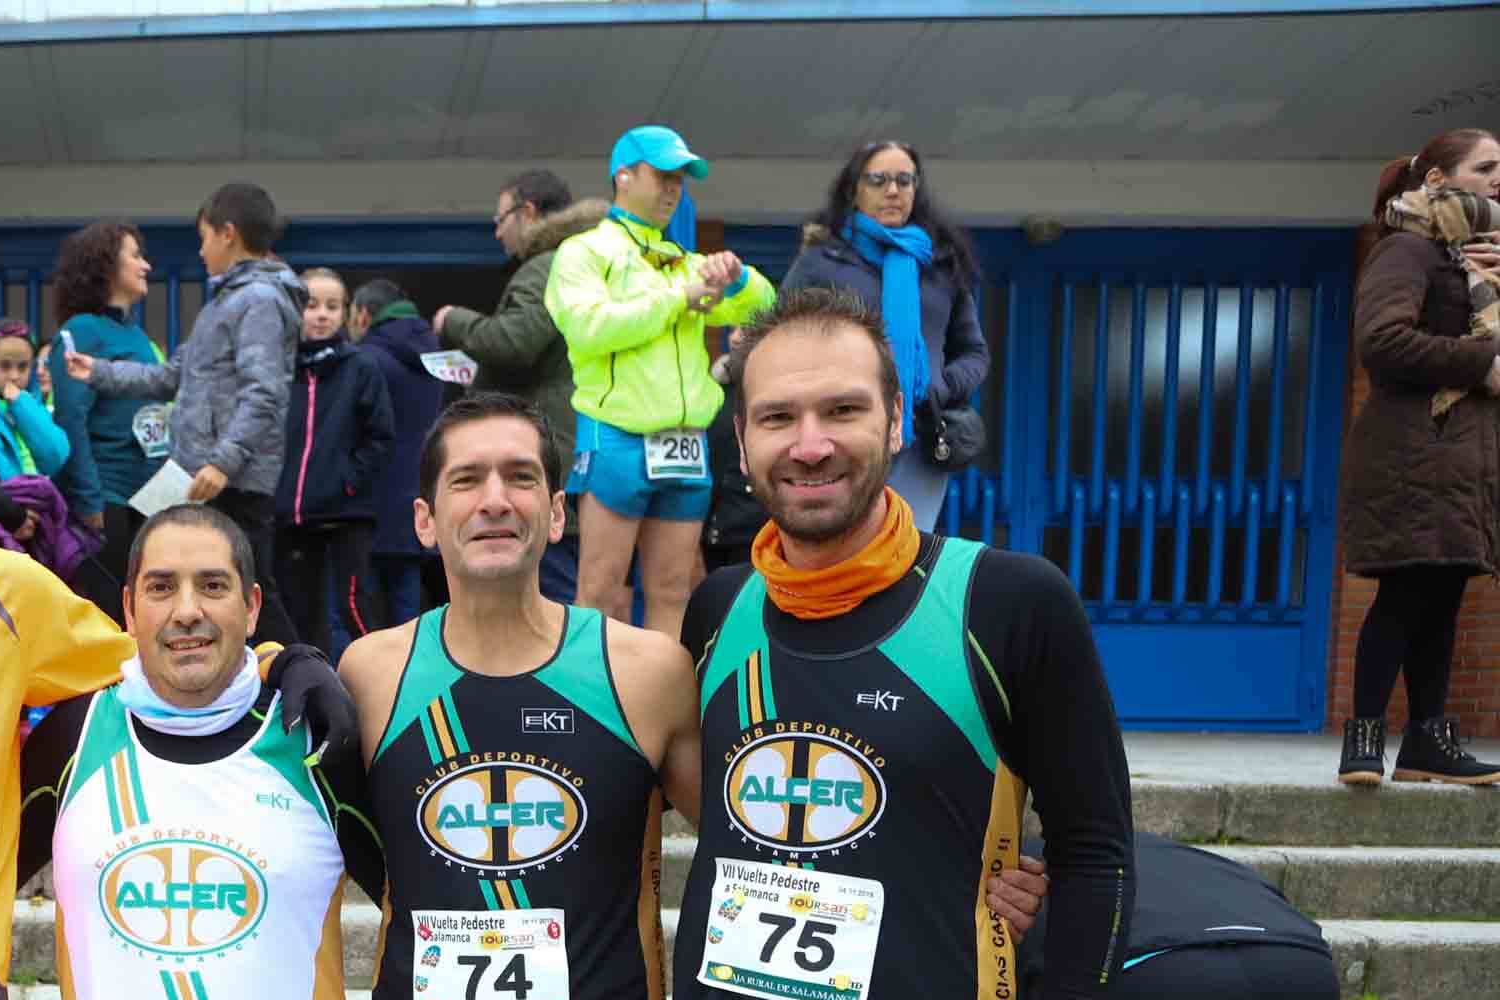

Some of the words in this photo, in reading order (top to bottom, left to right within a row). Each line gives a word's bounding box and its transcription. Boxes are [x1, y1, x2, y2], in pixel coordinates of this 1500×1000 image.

[663, 437, 700, 461] 260
[724, 728, 765, 763] CLUB
[775, 721, 886, 768] DEPORTIVO
[415, 762, 460, 795] CLUB
[469, 751, 584, 788] DEPORTIVO
[738, 775, 864, 816] ALCER
[436, 801, 567, 832] ALCER
[94, 836, 141, 870] CLUB
[153, 828, 268, 870] DEPORTIVO
[727, 823, 877, 860] SALAMANCA
[429, 844, 580, 878] SALAMANCA
[722, 863, 735, 876] VII
[737, 866, 768, 885] Vuelta
[771, 871, 821, 893] Pedestre
[115, 881, 248, 918] ALCER
[724, 884, 731, 893] a
[430, 915, 458, 930] Vuelta
[460, 916, 506, 930] Pedestre
[758, 912, 837, 973] 75
[747, 976, 775, 991] RURAL
[776, 982, 790, 993] DE
